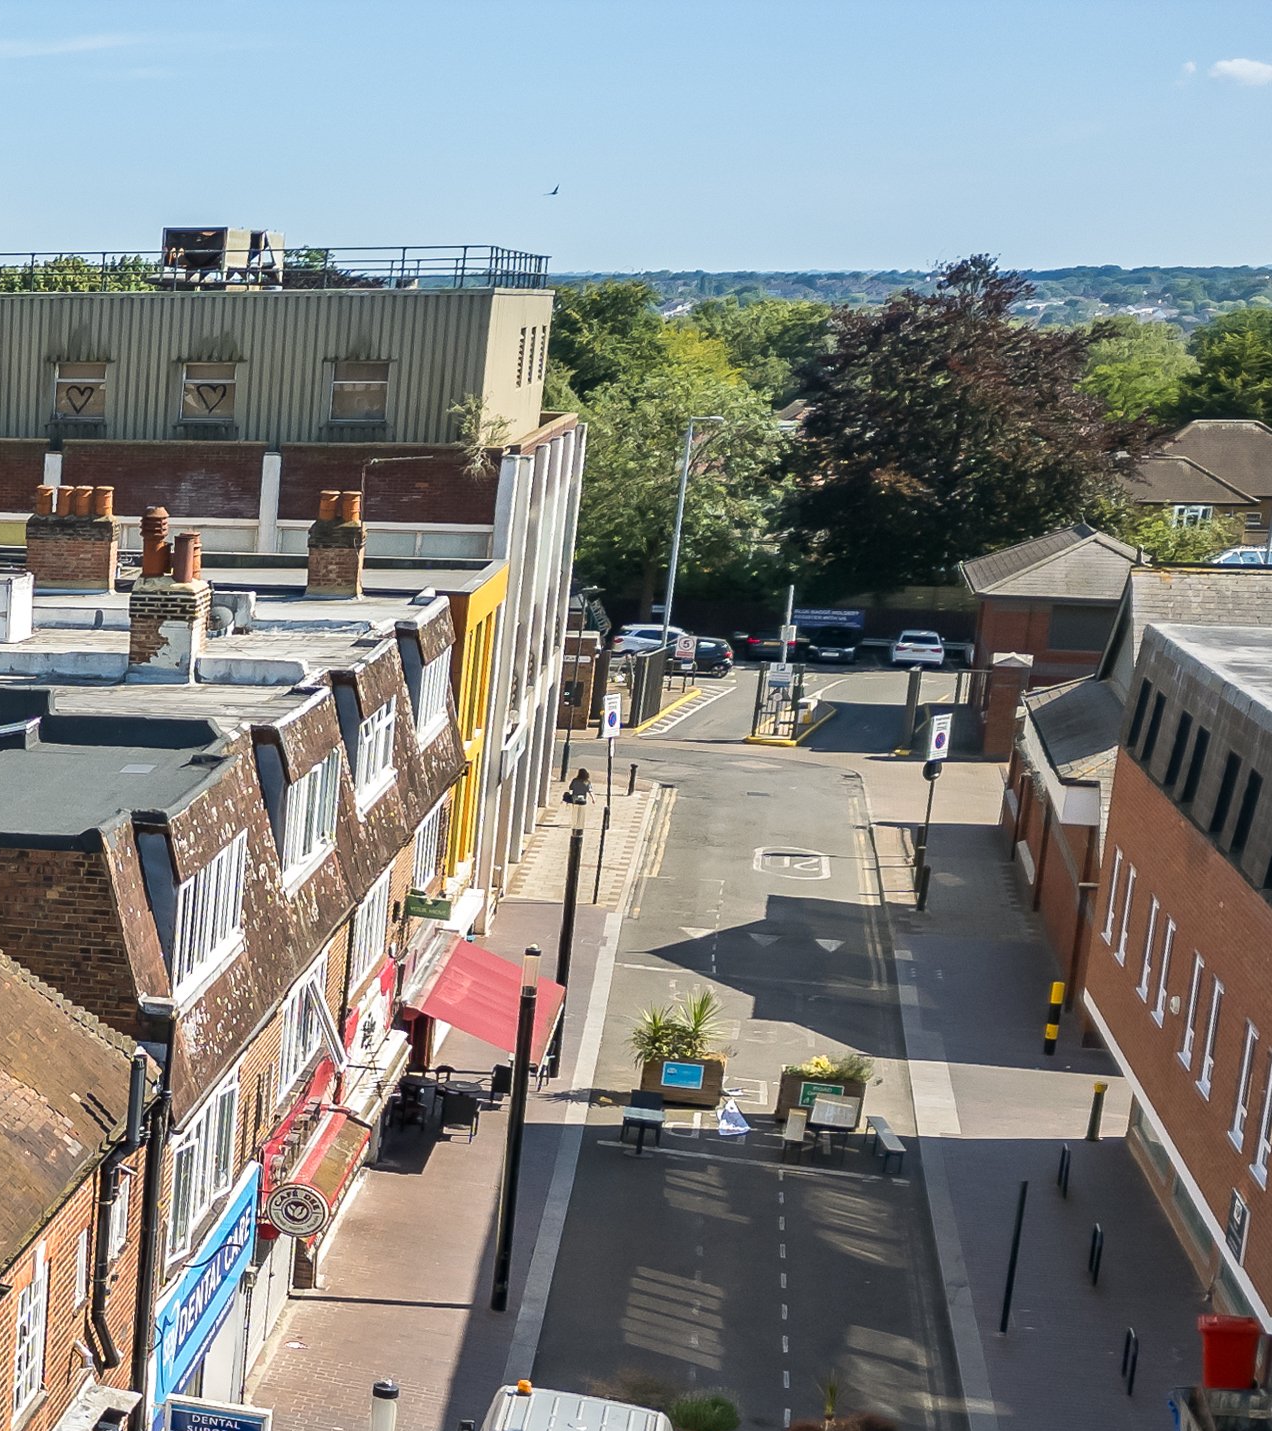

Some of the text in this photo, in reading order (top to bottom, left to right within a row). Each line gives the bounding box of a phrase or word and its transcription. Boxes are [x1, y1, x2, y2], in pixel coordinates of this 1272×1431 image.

[178, 1260, 222, 1346] DENTAL
[223, 1206, 252, 1272] CARE
[192, 1414, 241, 1430] DENTAL
